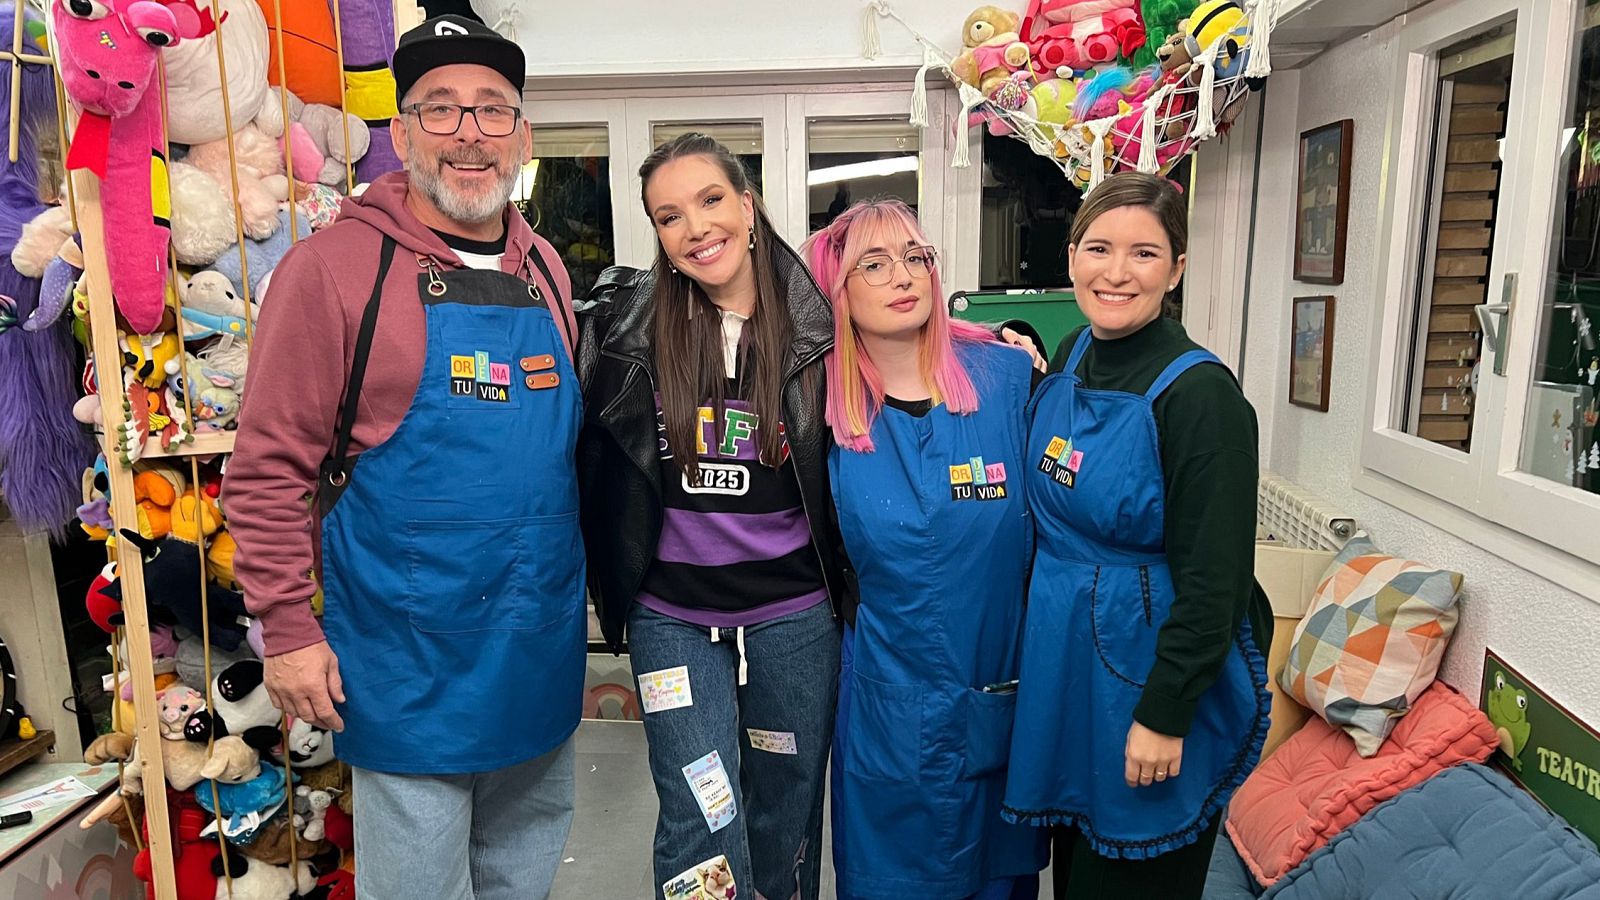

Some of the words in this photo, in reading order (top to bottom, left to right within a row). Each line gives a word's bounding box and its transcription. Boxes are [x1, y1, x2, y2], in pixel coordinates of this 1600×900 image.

[453, 353, 508, 381] ORDENA
[453, 380, 472, 394] TU
[480, 385, 507, 400] VIDA
[1041, 457, 1054, 472] TU
[1055, 467, 1073, 487] VIDA
[954, 485, 971, 499] TU
[978, 485, 1005, 499] VIDA
[1536, 746, 1600, 801] TEATR
